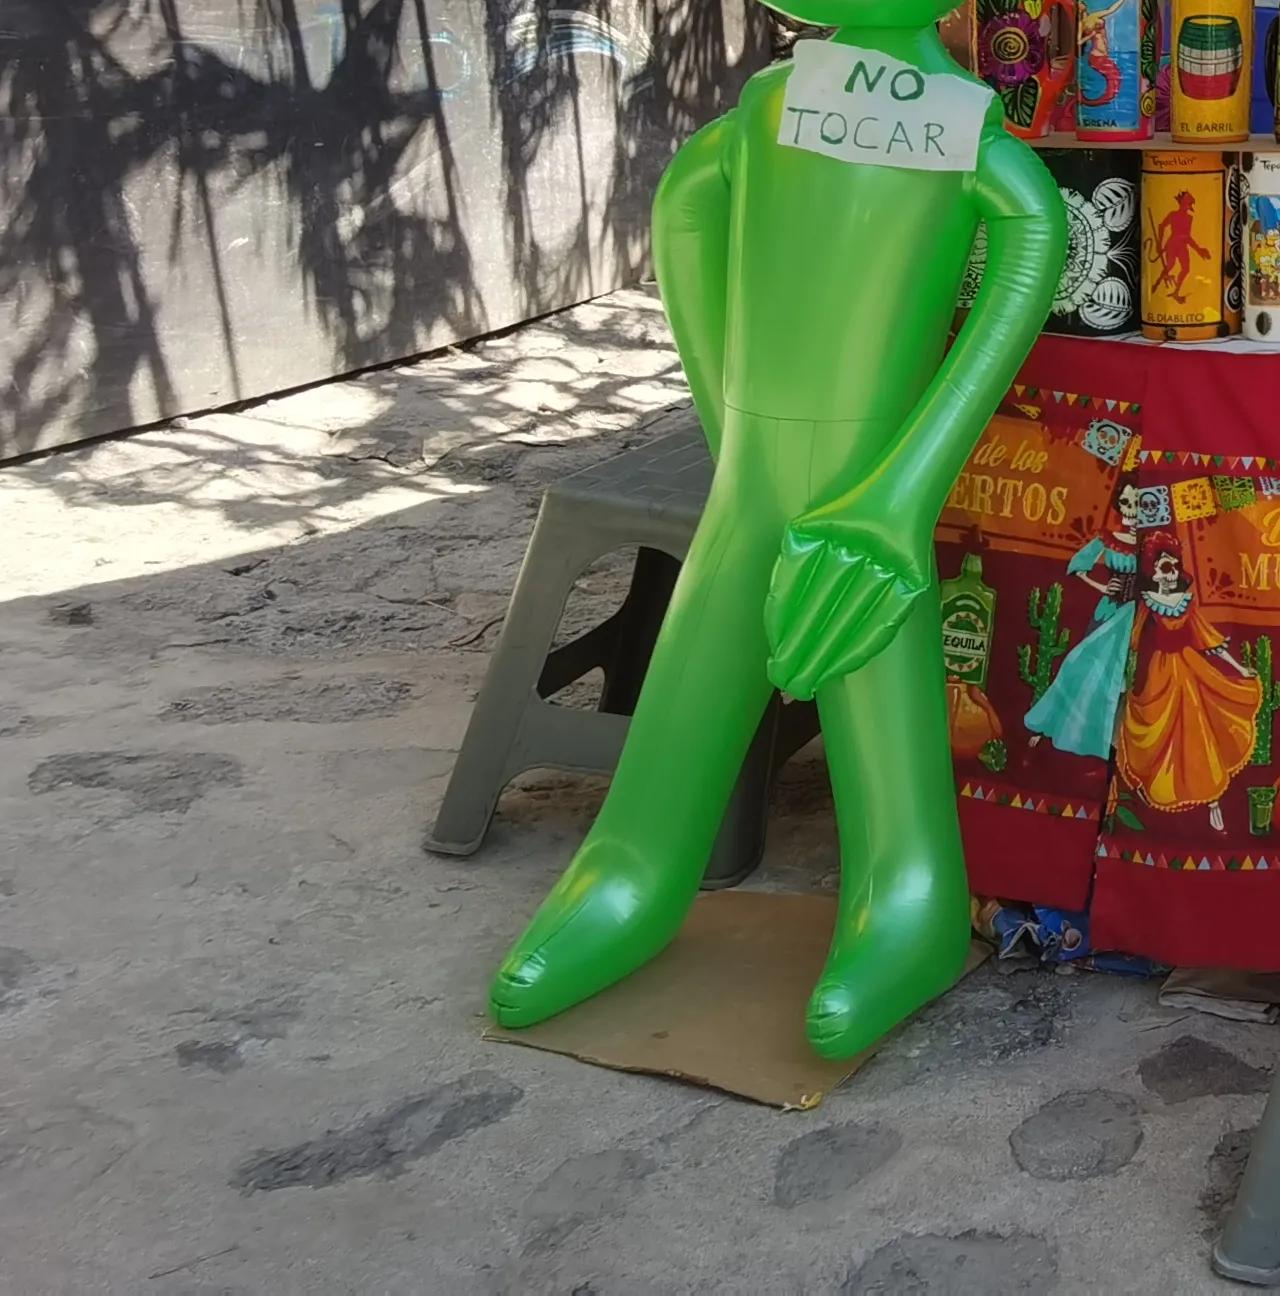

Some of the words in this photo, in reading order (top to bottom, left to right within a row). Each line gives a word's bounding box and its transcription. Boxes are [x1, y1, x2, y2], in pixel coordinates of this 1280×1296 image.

[844, 60, 925, 101] NO
[786, 106, 946, 157] TOCAR
[1180, 122, 1191, 132] EL
[1196, 122, 1234, 133] BARRIL
[1158, 312, 1205, 323] DIABLITO
[973, 434, 1007, 467] de
[1010, 439, 1049, 474] los
[947, 472, 1068, 526] ERTOS
[944, 635, 986, 652] EQUILA
